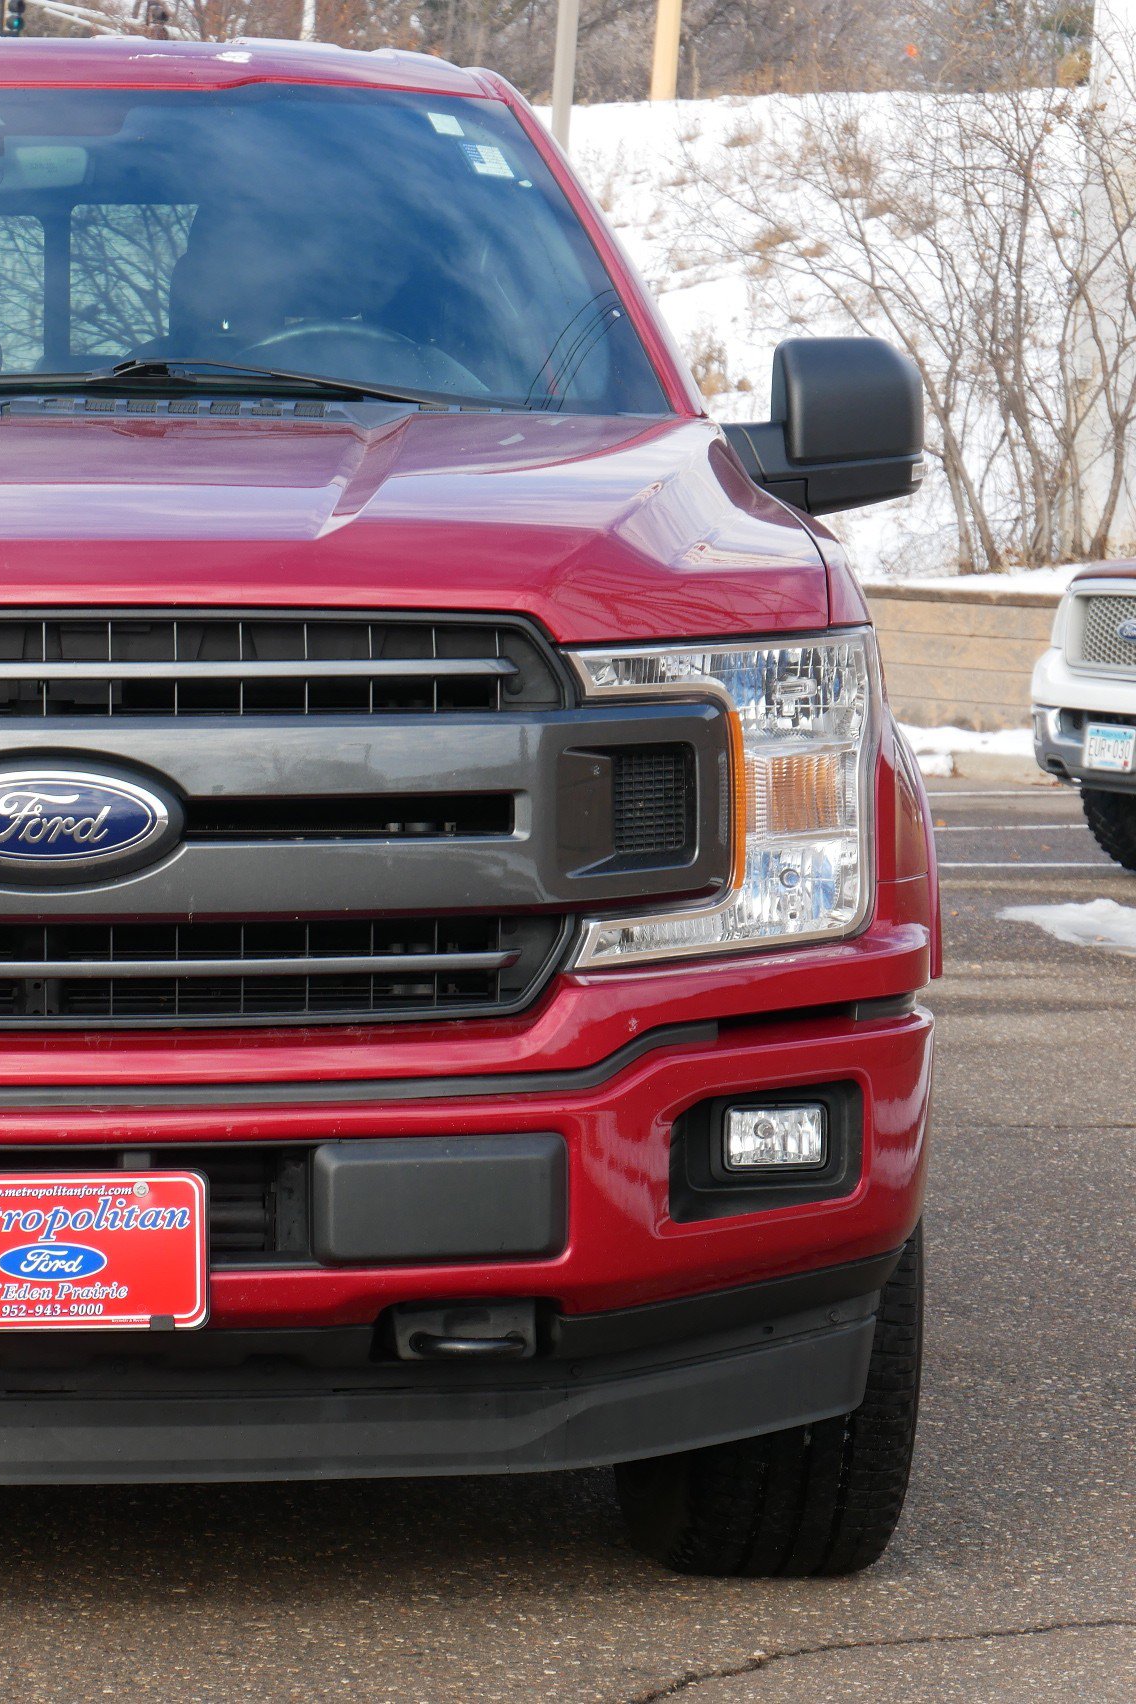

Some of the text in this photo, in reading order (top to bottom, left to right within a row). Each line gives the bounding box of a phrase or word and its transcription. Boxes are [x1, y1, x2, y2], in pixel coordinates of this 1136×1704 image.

[20, 1249, 83, 1273] Ford
[2, 1283, 52, 1300] Eden
[57, 1281, 128, 1300] Prairie
[1, 1303, 103, 1317] 952-943-9000
